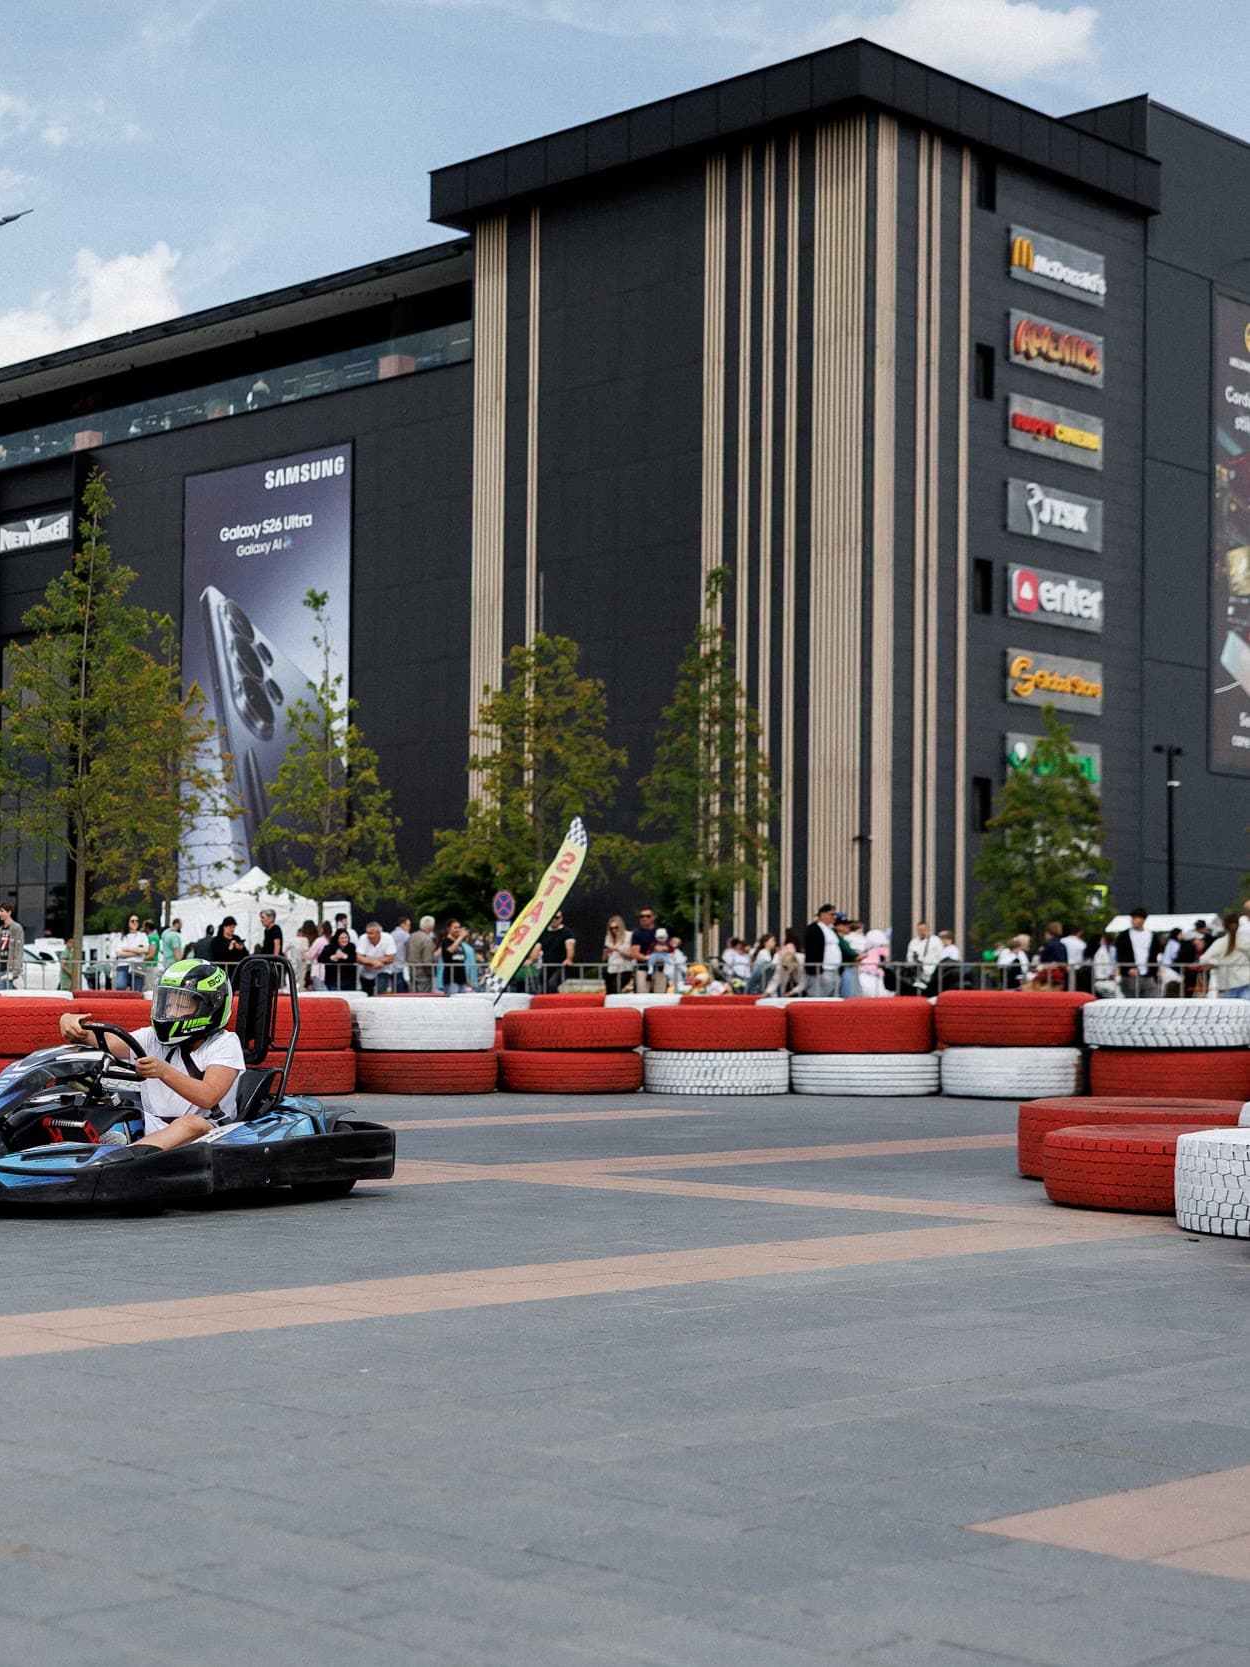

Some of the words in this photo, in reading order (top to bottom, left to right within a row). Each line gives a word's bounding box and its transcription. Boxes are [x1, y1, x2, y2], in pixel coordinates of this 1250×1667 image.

[264, 456, 345, 490] SAMSUNG
[219, 522, 261, 542] Galaxy
[262, 517, 282, 535] S26
[283, 513, 313, 531] Ultra
[236, 541, 272, 557] Galaxy
[272, 538, 282, 551] AI
[1039, 580, 1104, 619] enter
